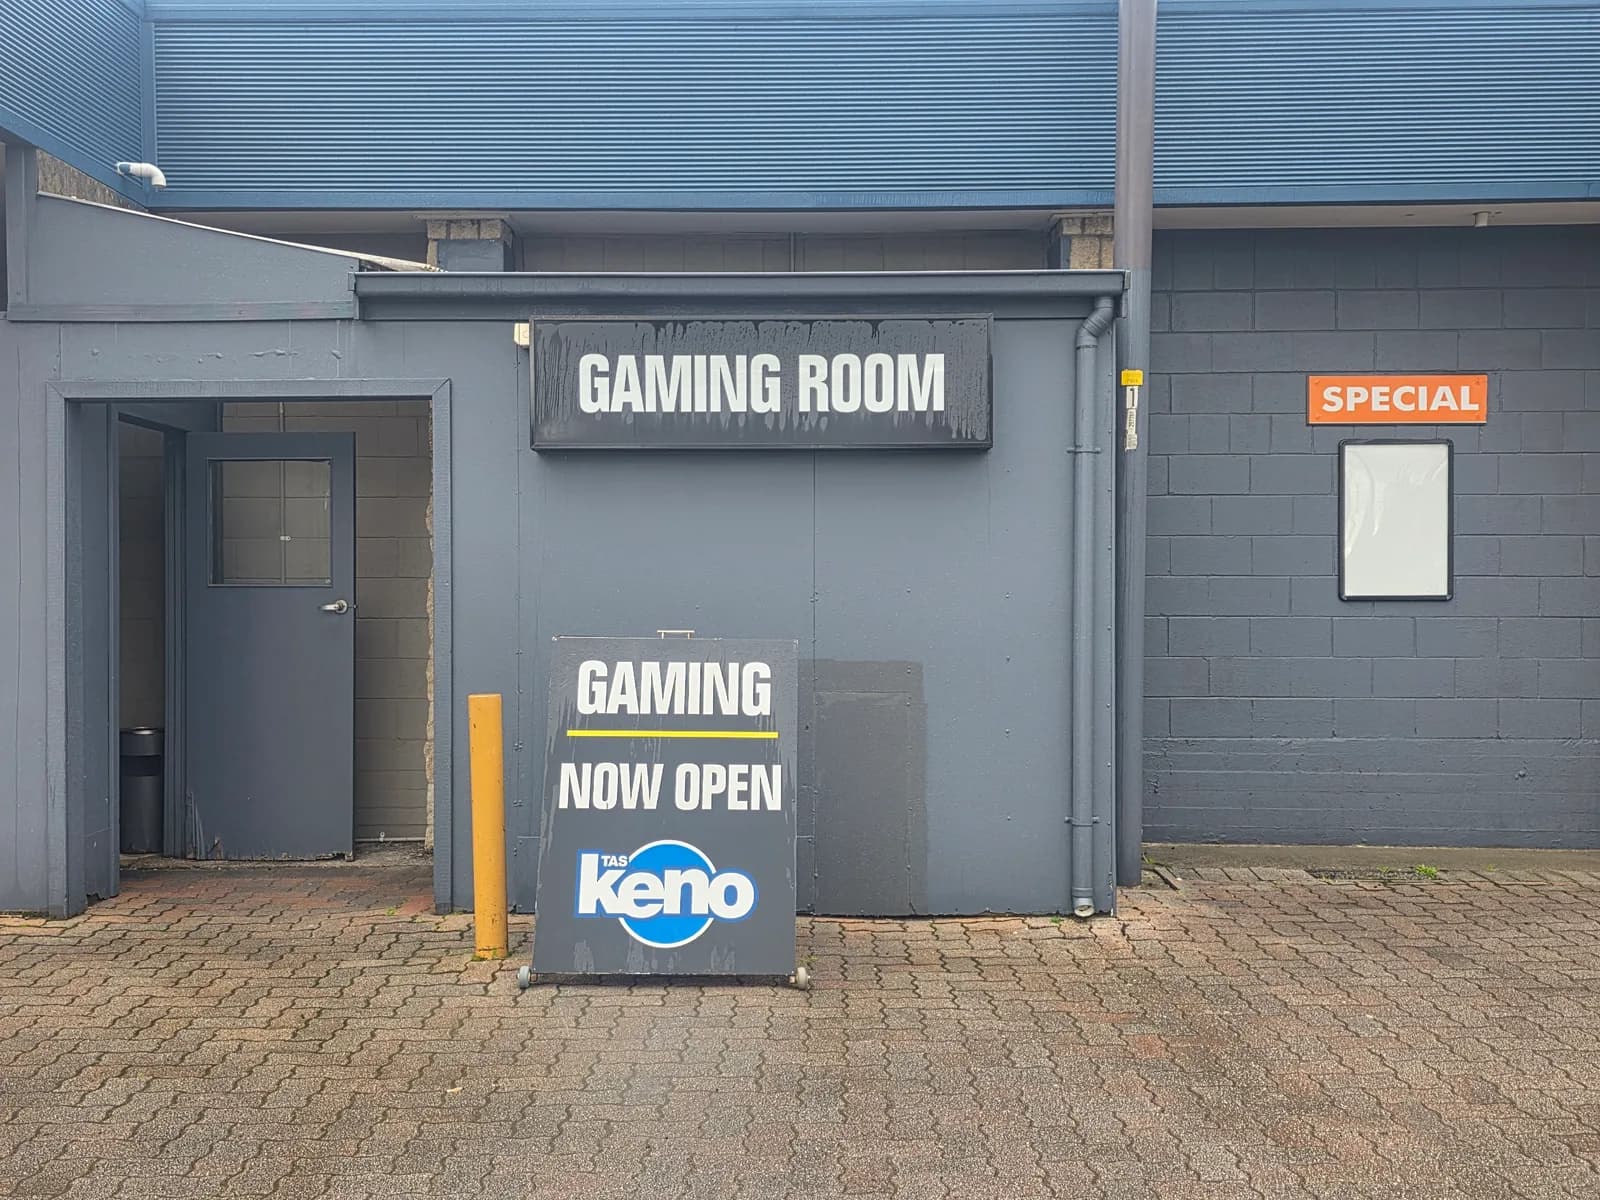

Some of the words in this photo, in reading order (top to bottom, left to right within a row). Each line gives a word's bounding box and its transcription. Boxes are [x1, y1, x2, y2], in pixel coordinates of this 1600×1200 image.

[578, 353, 782, 414] GAMING
[798, 353, 945, 414] ROOM
[1321, 385, 1480, 412] SPECIAL
[577, 660, 772, 716] GAMING
[558, 762, 664, 810] NOW
[674, 763, 782, 811] OPEN
[578, 853, 755, 919] keno
[601, 855, 628, 867] TAS
